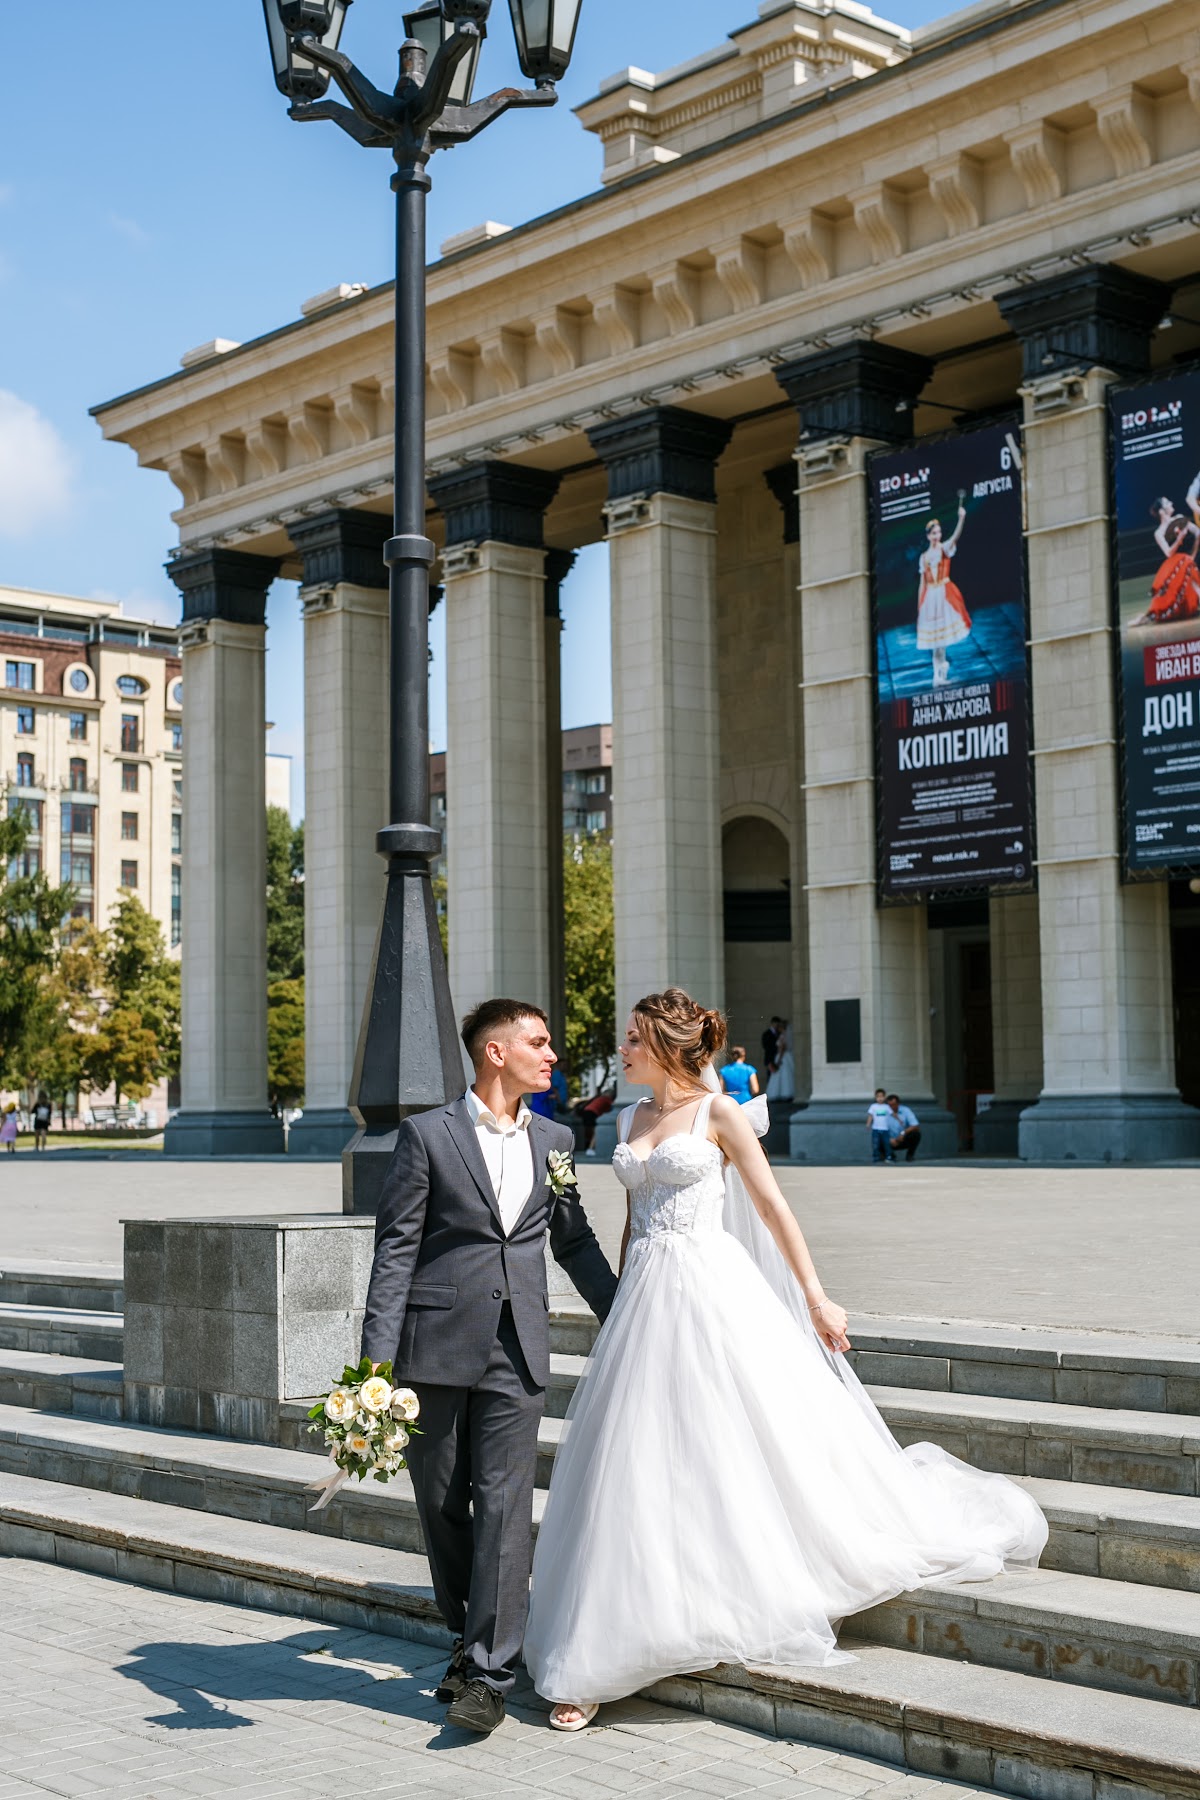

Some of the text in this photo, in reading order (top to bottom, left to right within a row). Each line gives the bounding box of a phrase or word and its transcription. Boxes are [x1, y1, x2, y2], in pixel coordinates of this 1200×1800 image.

[1000, 446, 1011, 471] 6
[973, 475, 1013, 498] АВГУСТА
[1155, 643, 1187, 660] ЗВЕЗДА
[1156, 656, 1191, 681] ИВАН
[912, 695, 921, 708] 25
[921, 692, 933, 706] ЛЕТ
[934, 691, 943, 703] НА
[943, 688, 964, 702] СЦЕНЕ
[912, 696, 992, 727] АННА ЖАРОВА
[1142, 691, 1193, 737] ДОН
[898, 722, 1009, 771] КОППЕЛИЯ
